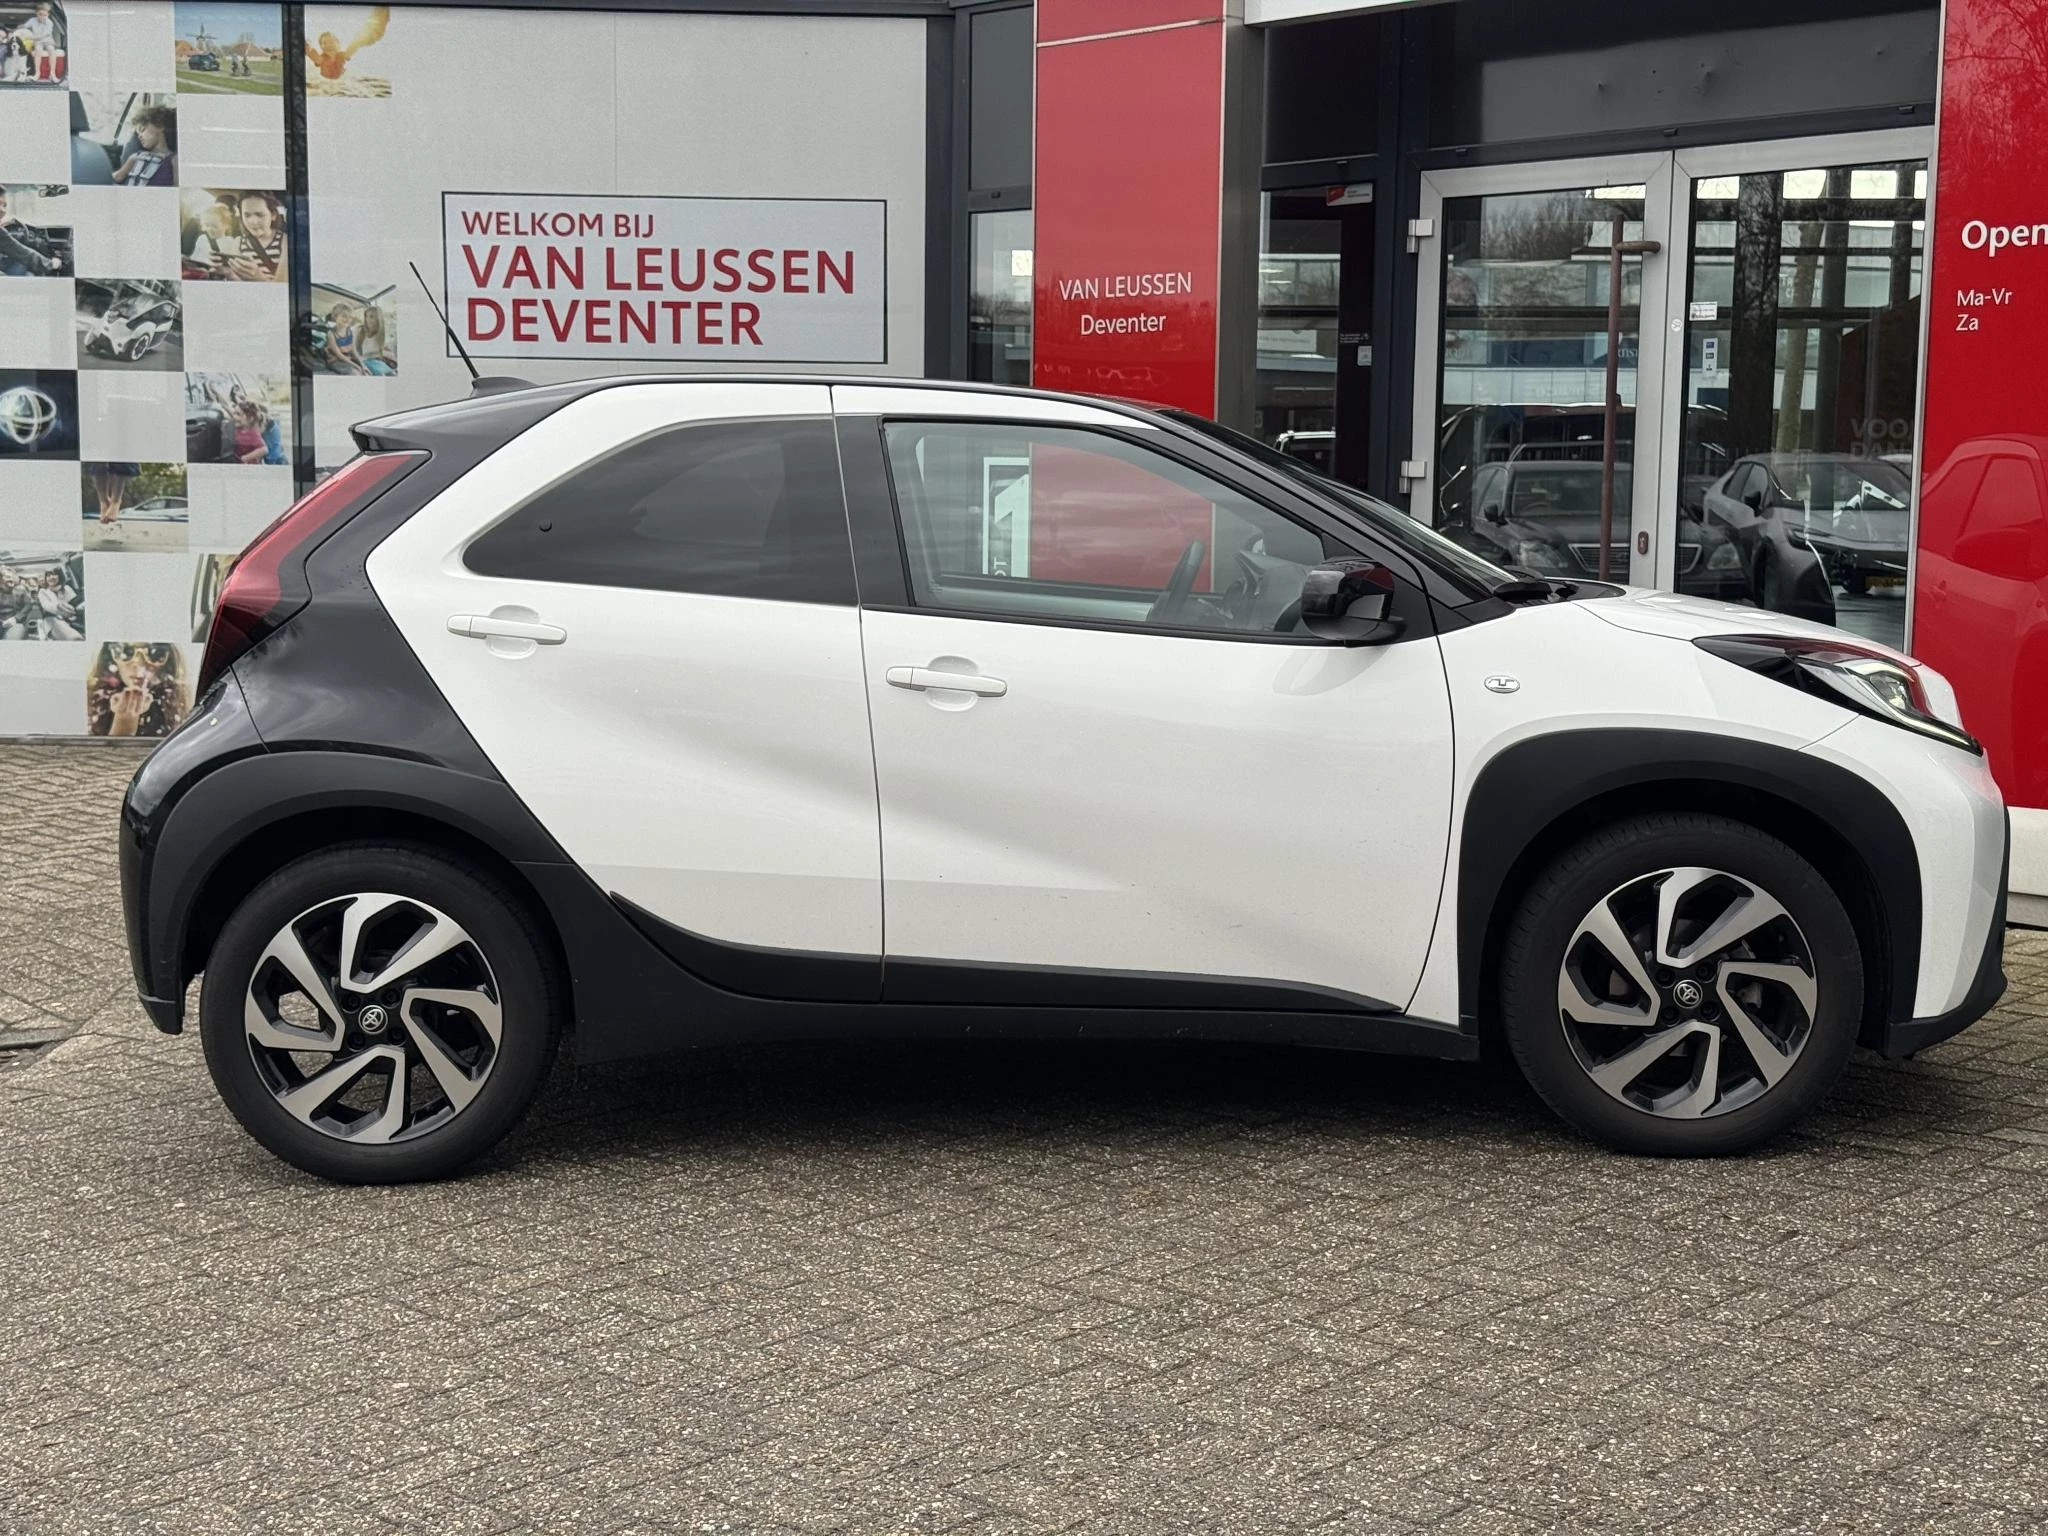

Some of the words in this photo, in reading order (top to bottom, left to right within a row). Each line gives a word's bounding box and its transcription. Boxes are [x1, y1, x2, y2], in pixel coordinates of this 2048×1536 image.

[461, 211, 603, 238] WELKOM
[614, 214, 655, 239] BIJ
[1961, 219, 2048, 258] Open
[462, 244, 585, 291] VAN
[606, 247, 855, 295] LEUSSEN
[1059, 278, 1099, 301] VAN
[1105, 272, 1192, 299] LEUSSEN
[1956, 288, 2013, 307] Ma-Vr
[467, 297, 764, 346] DEVENTER
[1080, 312, 1167, 336] Deventer
[1955, 313, 1979, 332] Za
